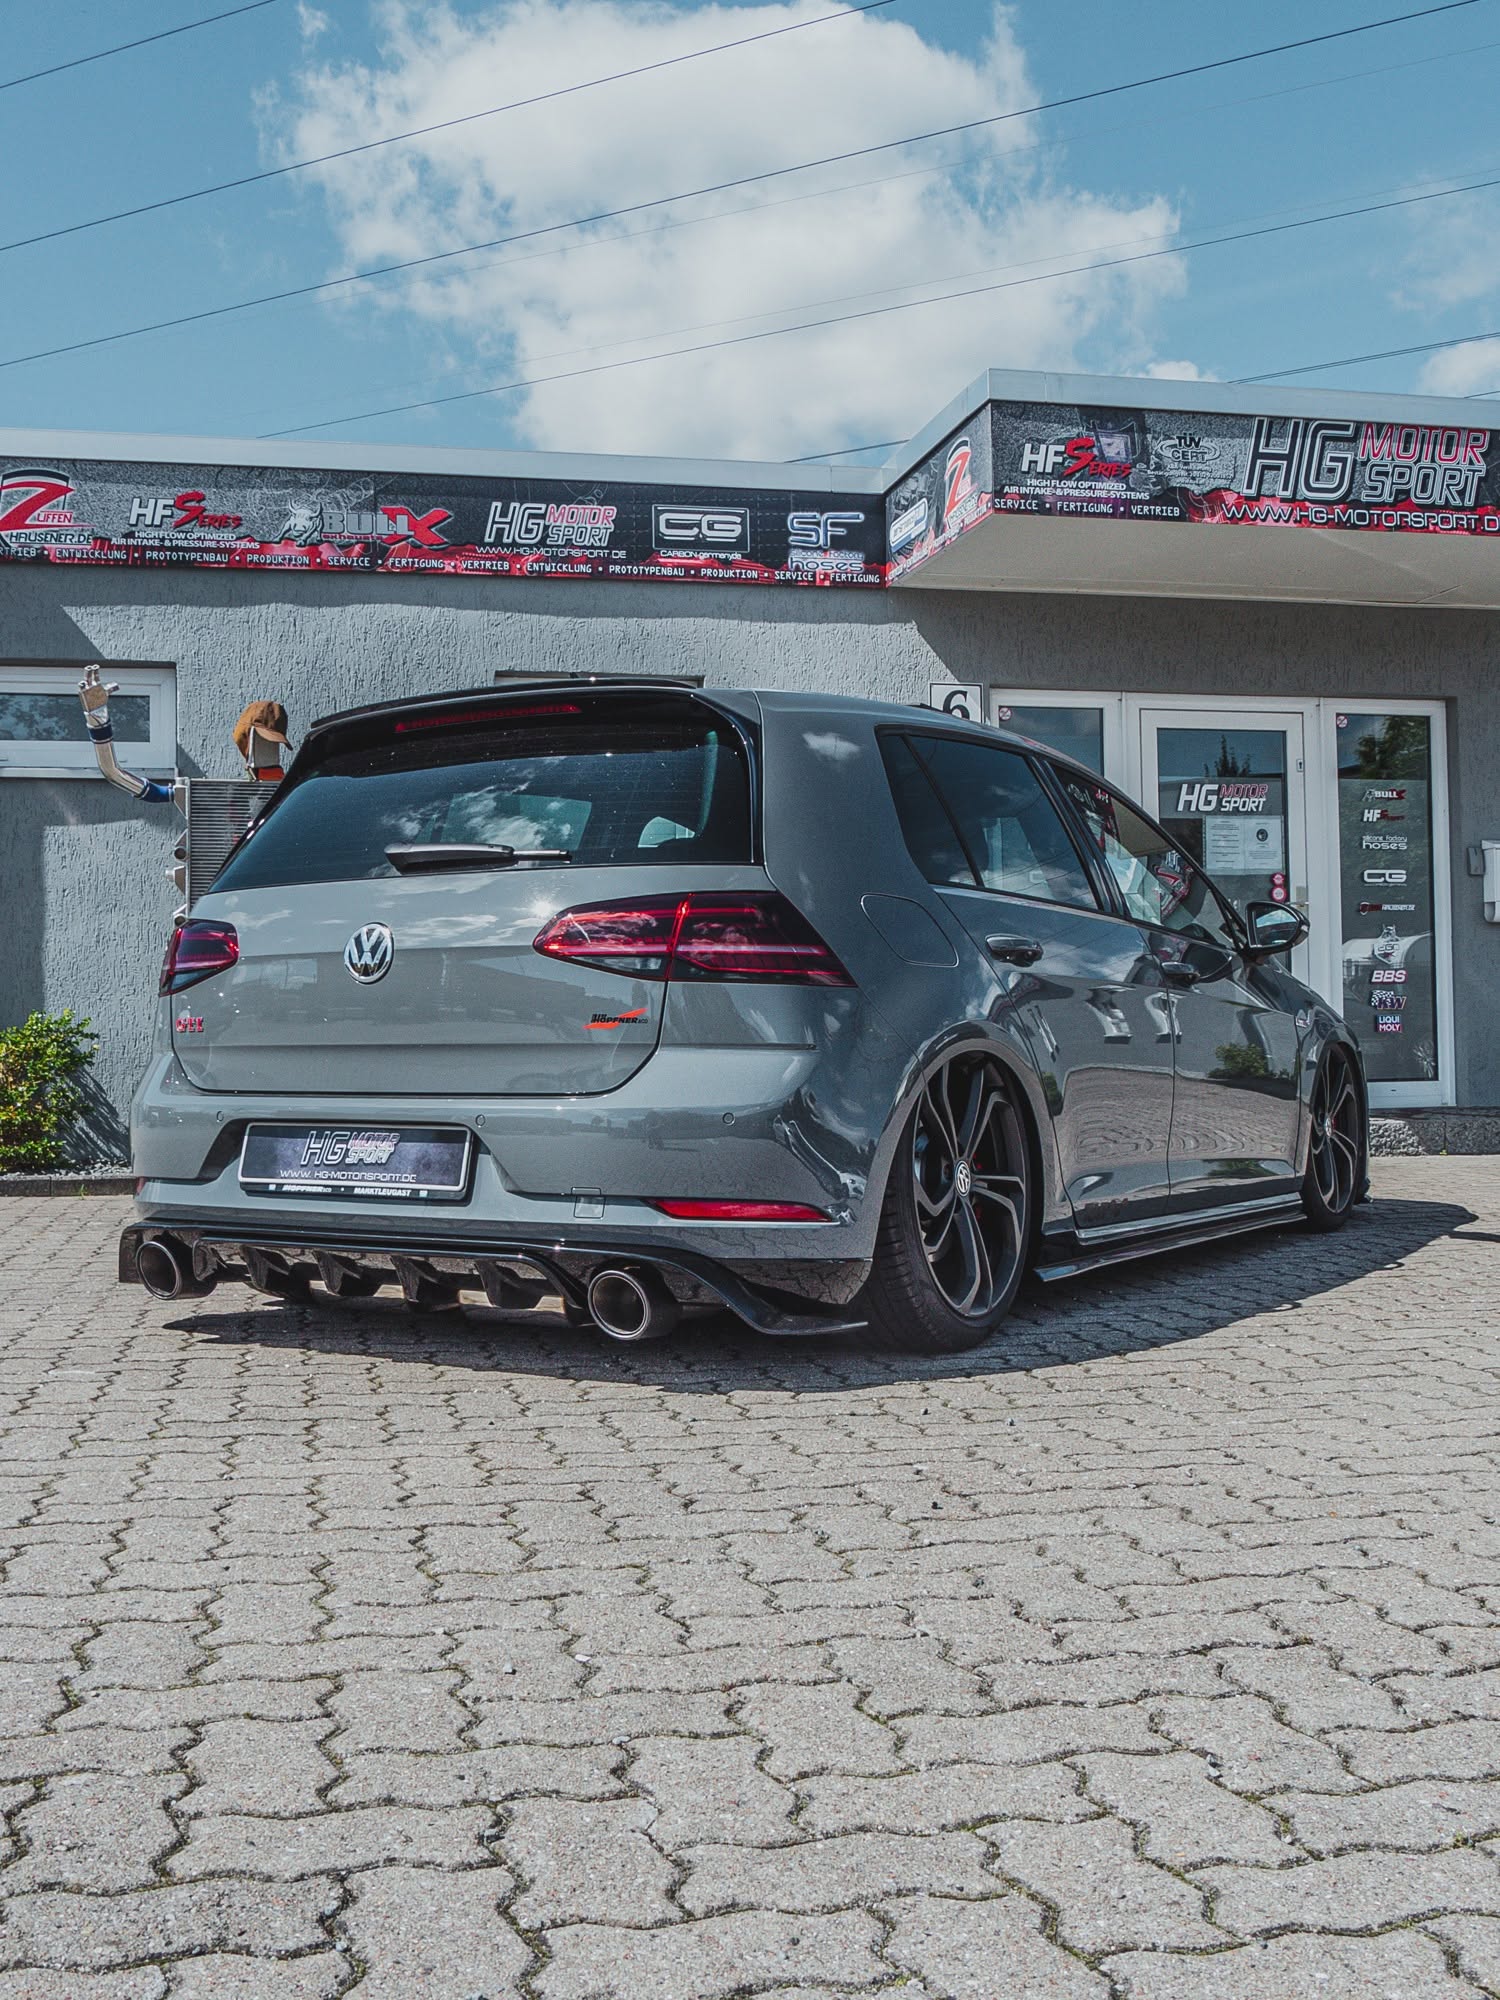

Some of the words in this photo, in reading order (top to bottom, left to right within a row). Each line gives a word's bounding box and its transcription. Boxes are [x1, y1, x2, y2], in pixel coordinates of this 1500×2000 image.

[1176, 432, 1201, 448] TÜV
[1358, 423, 1490, 465] MOTOR
[1171, 450, 1207, 462] CERT
[1240, 416, 1355, 500] HG
[1004, 486, 1019, 494] AIR
[1027, 479, 1051, 487] HIGH
[1051, 480, 1077, 489] FLOW
[1078, 481, 1126, 491] OPTIMIZED
[1361, 461, 1486, 506] SPORT
[546, 504, 617, 526] MOTOR
[994, 499, 1038, 510] SERVICE
[1057, 502, 1113, 514] FERTIGUNG
[1131, 505, 1180, 516] VERTRIEB
[484, 502, 546, 544] HG
[1222, 503, 1500, 532] WWW.HG-MOTORSPORT.D
[9, 531, 93, 545] HAUSENER.DE
[135, 531, 160, 540] HIGH
[159, 532, 186, 541] FLOW
[186, 532, 236, 542] OPTIMIZED
[546, 525, 613, 547] SPORT
[788, 512, 865, 548] SF
[56, 548, 127, 560] ENTWICKLUNG
[146, 551, 228, 562] PROTOTYPENBAU
[247, 553, 309, 565] PRODUKTION
[328, 556, 370, 567] SERVICE
[389, 558, 444, 569] FERTIGUNG
[462, 560, 509, 570] VERTRIEB
[527, 562, 592, 573] ENTWICKLUNG
[609, 565, 685, 577] PROTOTYPENBAU
[701, 568, 757, 579] PRODUKTION
[774, 571, 814, 581] SERVICE
[830, 573, 880, 583] FERTIGUNG
[790, 557, 864, 572] hoses
[943, 690, 970, 720] 6
[1177, 783, 1218, 811] HG
[1219, 783, 1269, 798] MOTOR
[1221, 798, 1266, 812] SPORT
[1362, 841, 1407, 850] hoses
[1363, 869, 1407, 883] CG
[1371, 970, 1406, 982] BBS
[1379, 1024, 1401, 1032] MOLY
[300, 1131, 349, 1165] HG
[348, 1131, 399, 1149] MOTOR
[346, 1148, 396, 1164] SPORT
[354, 1187, 411, 1197] MARKTLEUGAST
